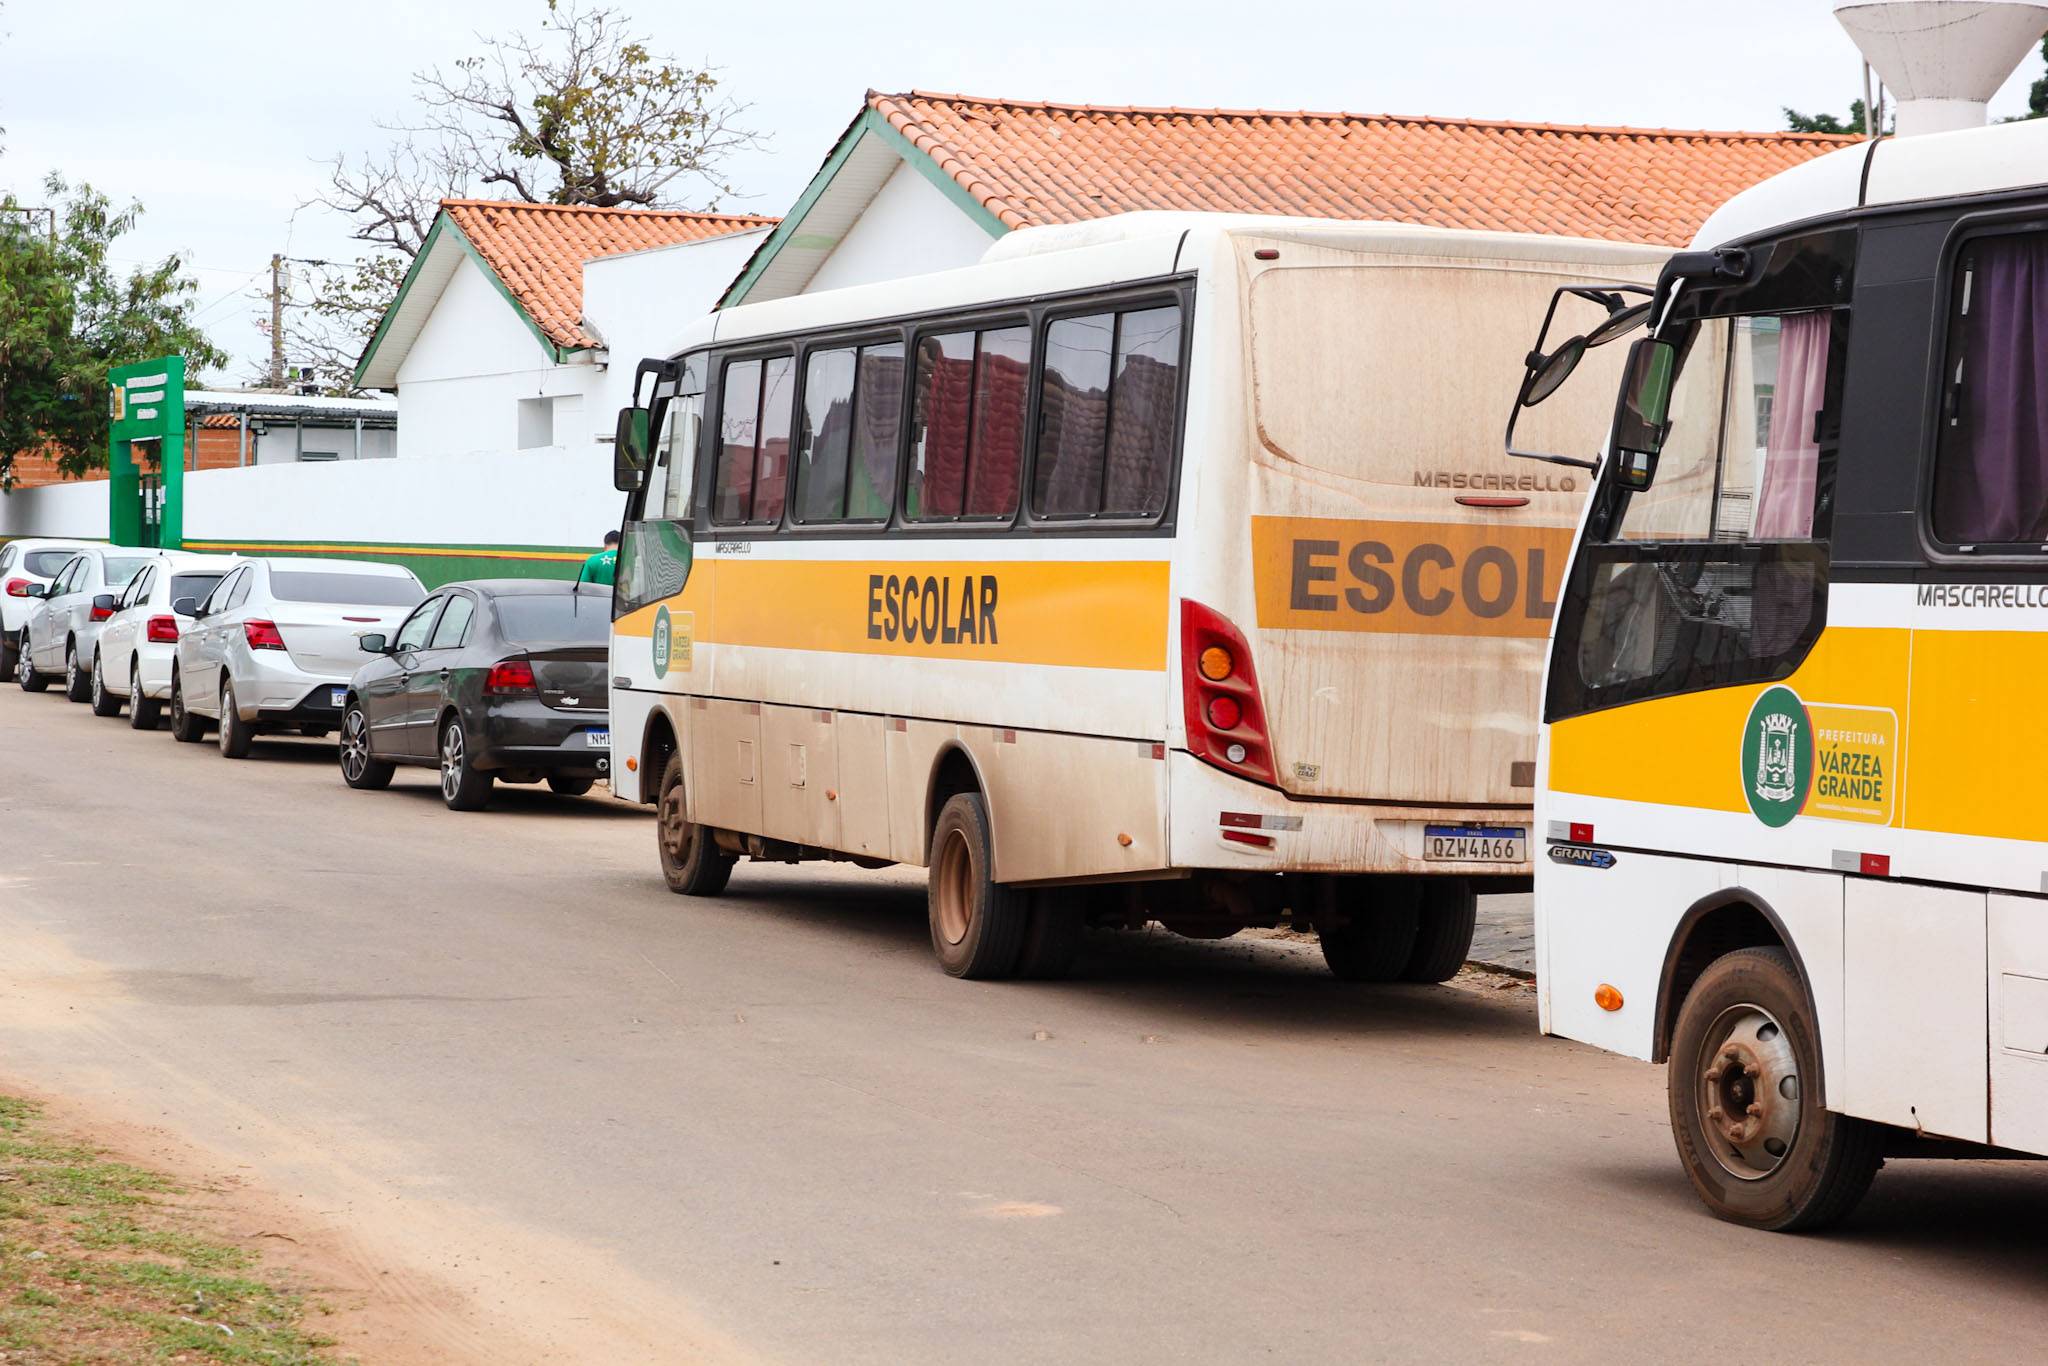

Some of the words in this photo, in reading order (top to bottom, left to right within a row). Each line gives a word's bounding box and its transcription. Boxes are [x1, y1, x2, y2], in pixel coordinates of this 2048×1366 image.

[1413, 471, 1577, 493] MASCARELLO
[1290, 538, 1557, 620] ESCOL
[867, 574, 999, 645] ESCOLAR
[1818, 728, 1886, 746] PREFEITURA
[1818, 743, 1883, 778] VÁRZEA
[1817, 775, 1882, 802] GRANDE
[1433, 837, 1514, 859] QZW4A66
[1551, 846, 1593, 861] GRAN
